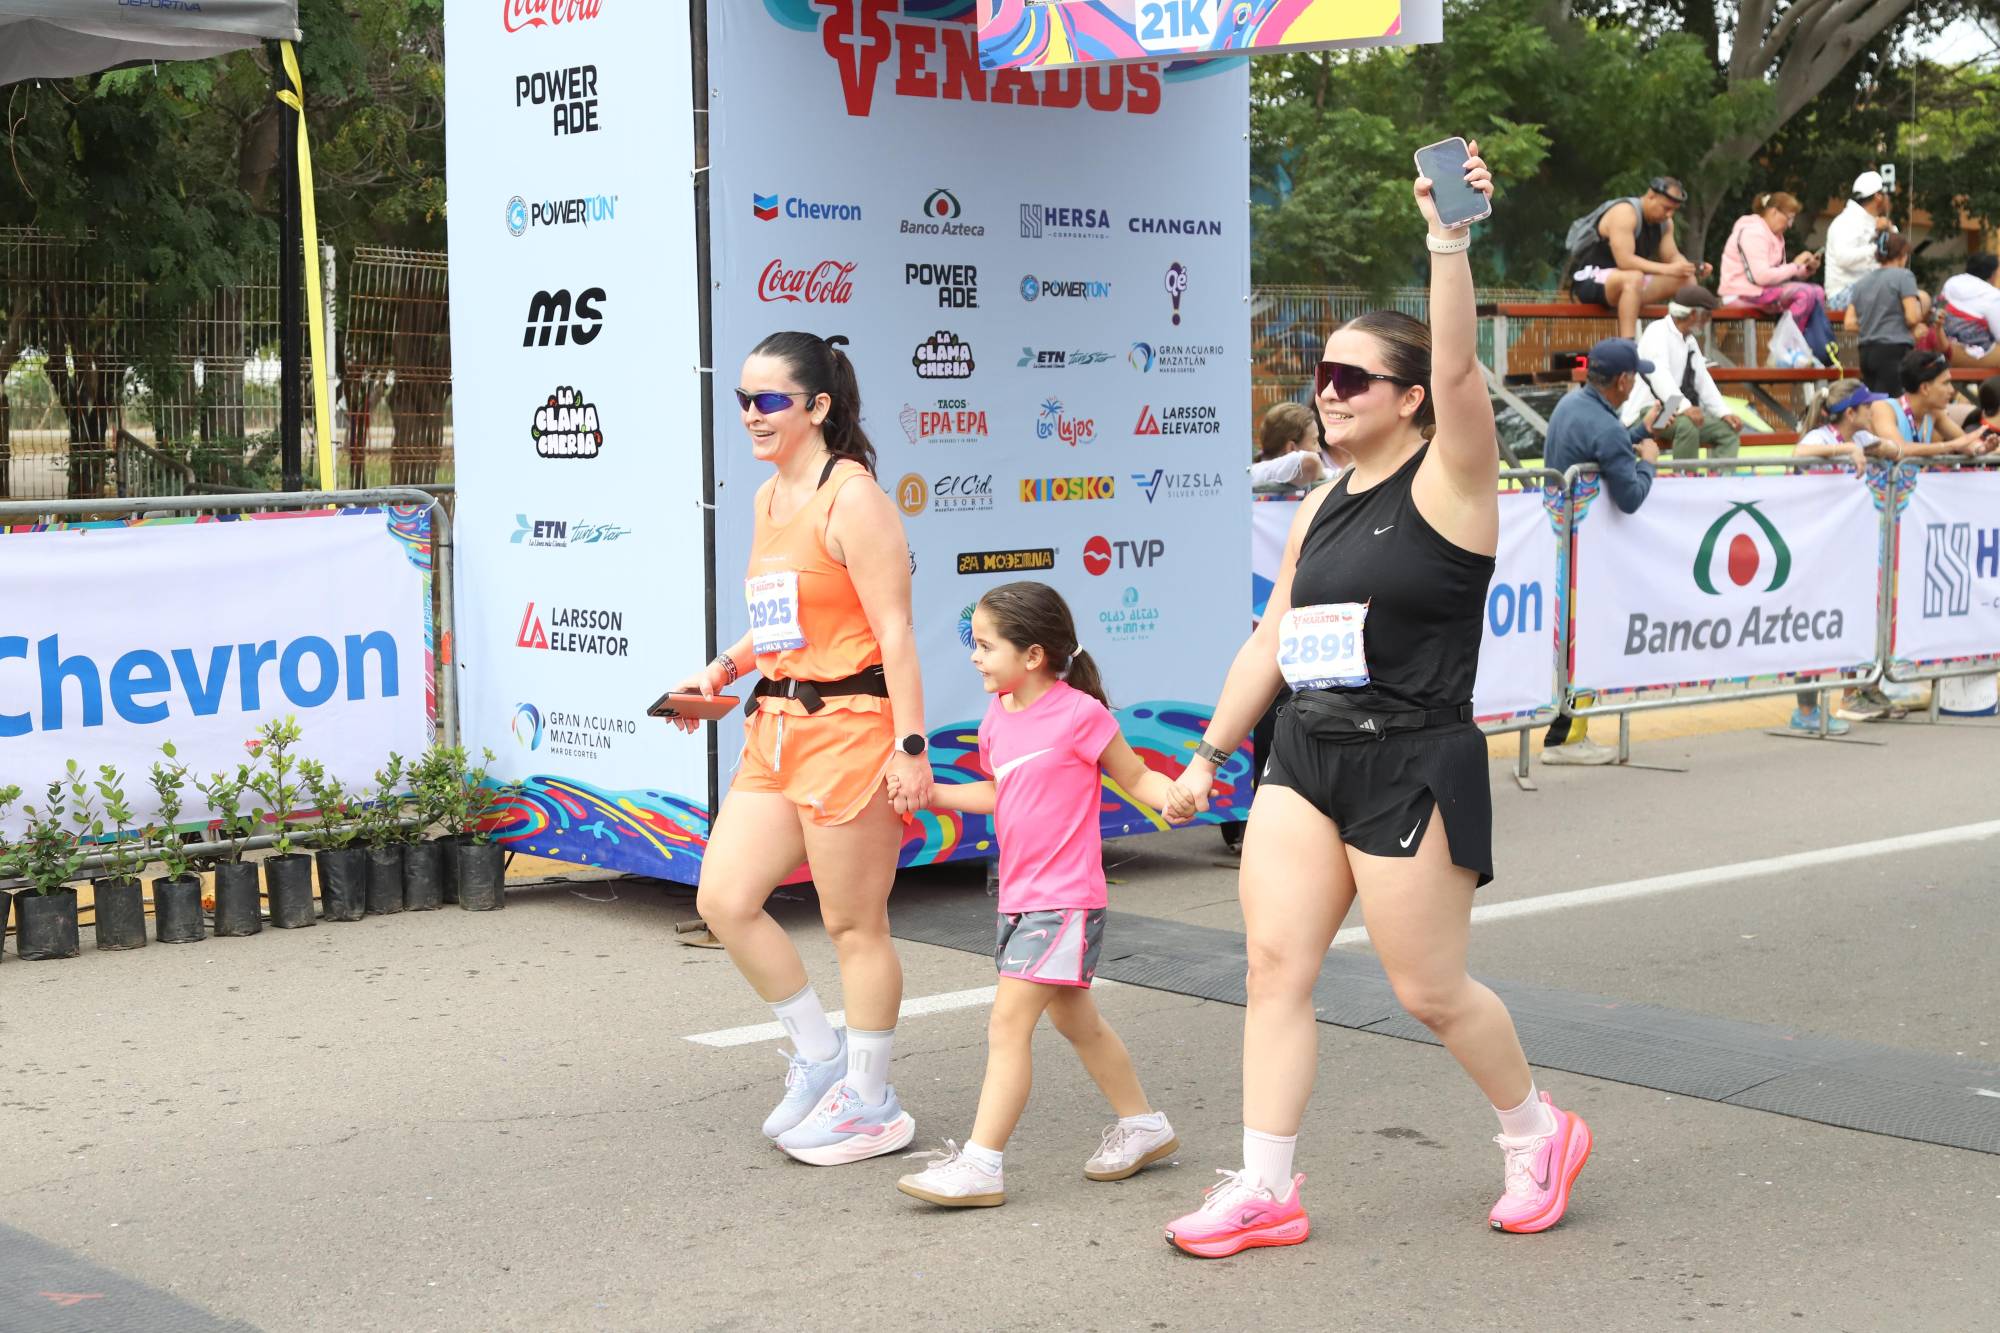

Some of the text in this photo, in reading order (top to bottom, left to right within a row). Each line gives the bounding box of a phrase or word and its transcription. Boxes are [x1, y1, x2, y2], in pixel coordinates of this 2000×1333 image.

[1141, 3, 1210, 41] 21K
[516, 64, 598, 107] POWER
[553, 99, 599, 136] ADE
[786, 197, 862, 221] Chevron
[1045, 206, 1111, 229] HERSA
[900, 220, 985, 237] Banco Azteca
[1128, 217, 1222, 236] CHANGAN
[757, 259, 858, 304] Coca-Cola
[905, 263, 977, 286] POWER
[938, 287, 978, 309] ADE
[937, 333, 950, 343] LA
[917, 345, 970, 362] CLAMA
[1037, 351, 1066, 363] ETN
[1159, 346, 1224, 355] GRAN ACUARIO
[557, 389, 574, 405] LA
[938, 400, 967, 409] TACOS
[535, 406, 598, 432] CLAMA
[1162, 406, 1217, 420] LARSSON
[1058, 414, 1094, 447] Lujos
[1162, 421, 1220, 435] ELEVATOR
[934, 474, 993, 496] El Cid
[1019, 476, 1114, 502] KIOSKO
[1165, 473, 1223, 488] VIZSLA
[934, 497, 993, 507] RESORTS
[533, 520, 567, 539] ETN
[1112, 539, 1165, 569] TVP
[551, 607, 623, 631] LARSSON
[750, 597, 791, 628] 2925
[1623, 605, 1844, 656] Banco Azteca
[550, 632, 629, 657] ELEVATOR
[1281, 632, 1355, 666] 2899
[550, 711, 636, 735] GRAN ACUARIO
[550, 729, 611, 749] MAZATLÁN
[550, 747, 563, 755] MAR
[564, 748, 572, 756] DE
